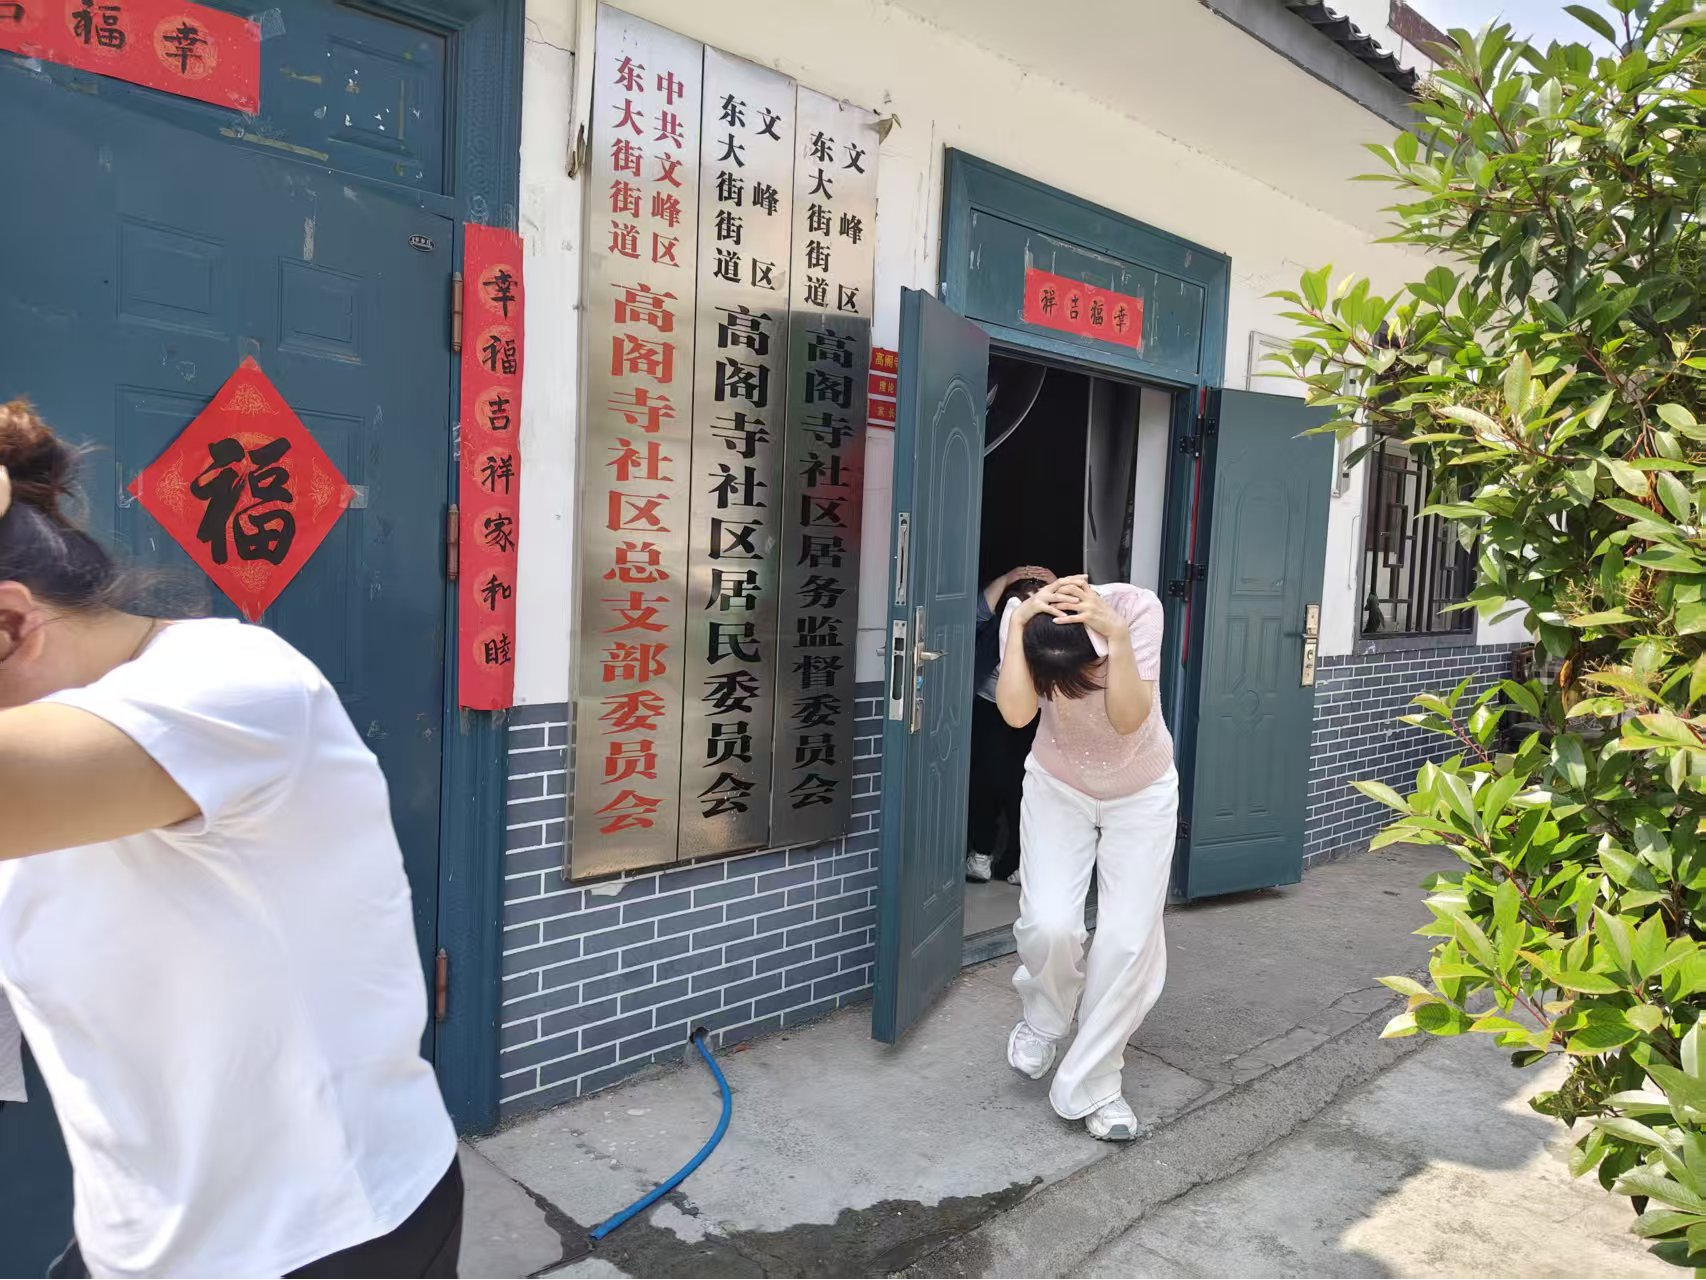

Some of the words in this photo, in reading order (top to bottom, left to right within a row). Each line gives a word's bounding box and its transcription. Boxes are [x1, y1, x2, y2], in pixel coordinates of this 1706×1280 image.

[608, 55, 645, 260] 东大街街道
[652, 71, 684, 268] 中共文峰区
[712, 94, 747, 284] 东大街街道
[750, 107, 781, 291] 文峰区
[803, 130, 835, 308] 东大街街道
[836, 142, 866, 314] 文峰区
[189, 436, 296, 566] 福
[481, 269, 518, 666] 幸福吉祥家和睦
[594, 283, 679, 835] 高阁寺社区总支部委员会
[697, 304, 772, 818] 高阁寺社区居民委员会
[786, 328, 857, 809] 高阁寺社区居务监督委员会
